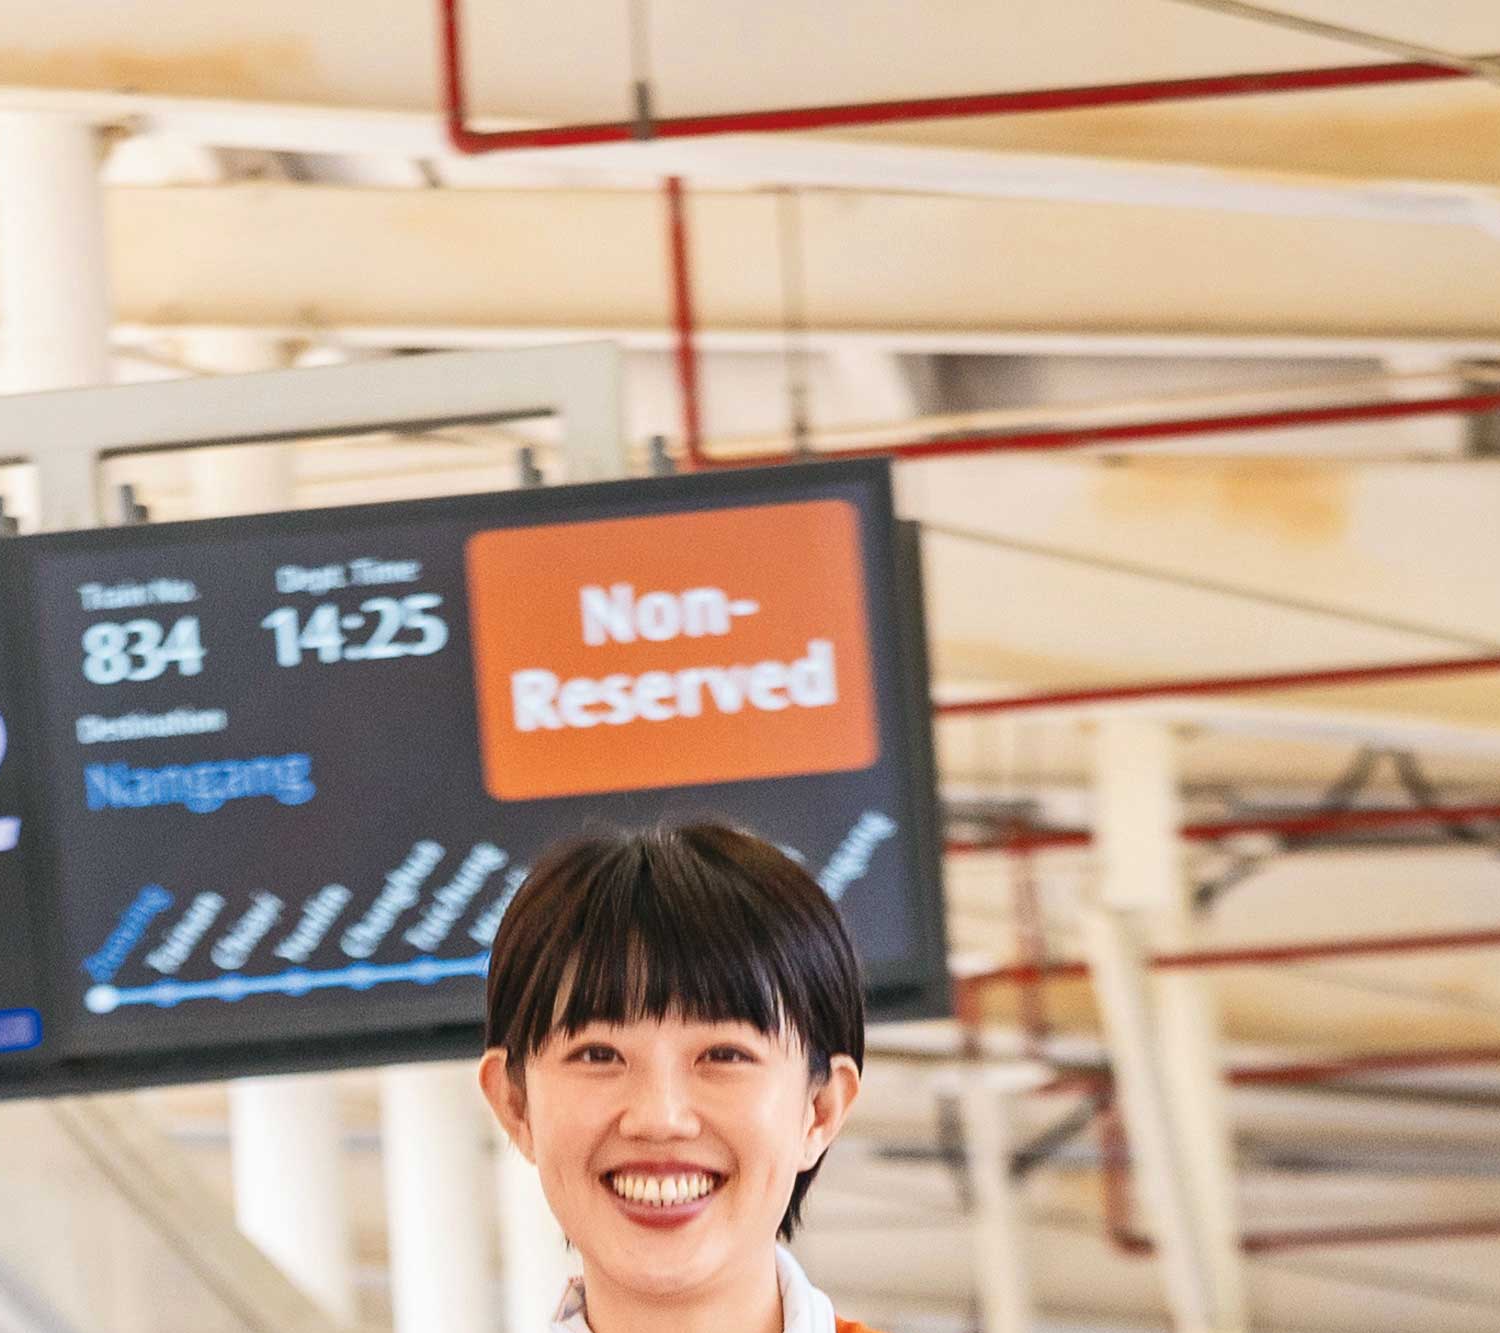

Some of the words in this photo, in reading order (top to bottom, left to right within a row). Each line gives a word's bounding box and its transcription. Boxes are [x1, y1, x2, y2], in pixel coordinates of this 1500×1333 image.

[261, 593, 449, 667] 14:25
[578, 581, 761, 647] Non-
[82, 615, 206, 684] 834
[510, 638, 839, 733] Reserved
[84, 752, 316, 813] Nangang
